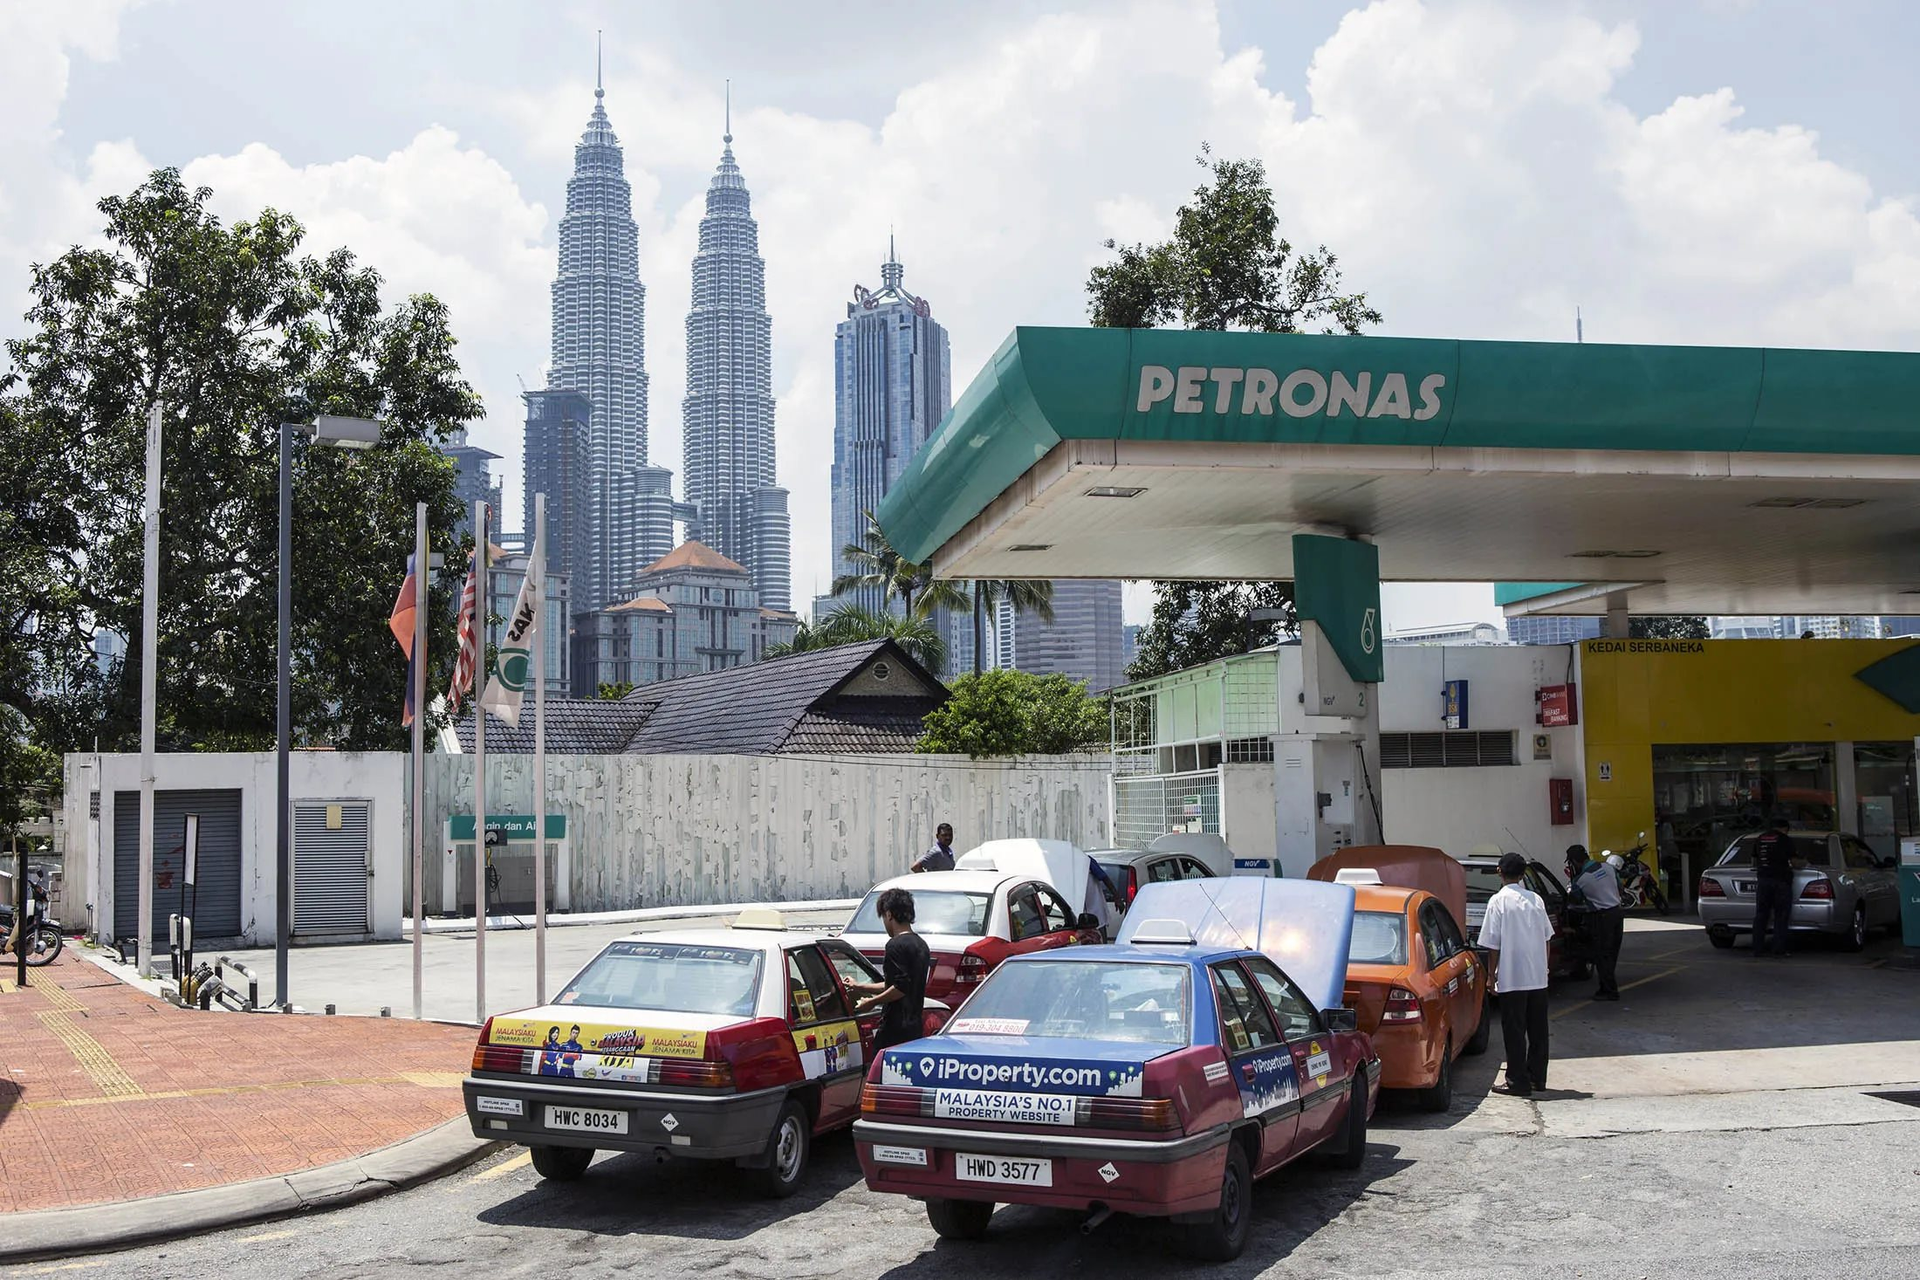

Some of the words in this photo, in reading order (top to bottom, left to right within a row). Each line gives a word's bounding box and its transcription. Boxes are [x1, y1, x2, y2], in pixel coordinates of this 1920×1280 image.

[1136, 366, 1446, 421] PETRONAS
[1588, 641, 1626, 653] KEDAI
[1629, 641, 1704, 653] SERBANEKA
[1358, 691, 1365, 707] 2
[504, 821, 522, 831] dan
[495, 1028, 537, 1037] MALAYSIAKU
[603, 1028, 636, 1039] PRODUK
[651, 1038, 698, 1048] MALAYSIAKU
[597, 1053, 634, 1069] KITA
[938, 1058, 1101, 1087] iProperty.com
[939, 1092, 1032, 1109] MALAYSIA'S
[1038, 1098, 1072, 1112] NO.1
[554, 1109, 579, 1125] HWC
[584, 1112, 618, 1129] 8034
[949, 1107, 1005, 1119] PROPERTY
[1011, 1111, 1060, 1123] WEBSITE
[967, 1158, 996, 1177] HWD
[1001, 1162, 1040, 1181] 3577
[1101, 1168, 1116, 1178] NGV
